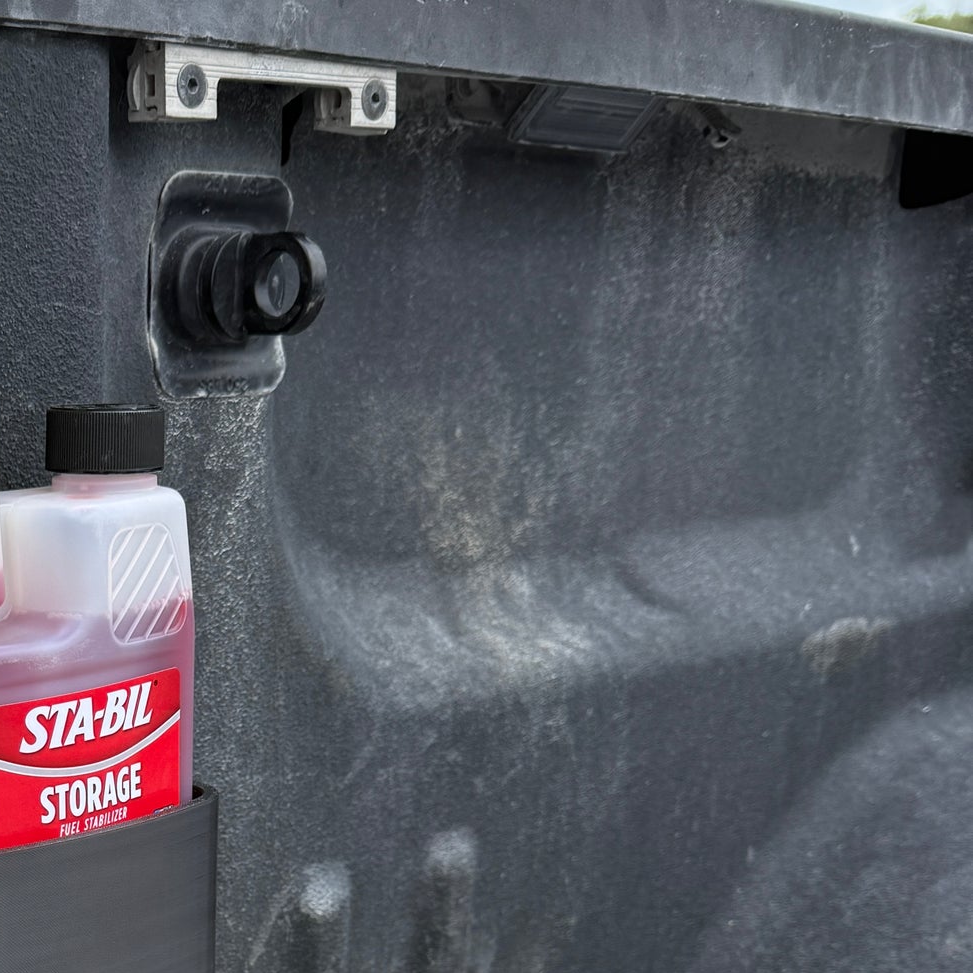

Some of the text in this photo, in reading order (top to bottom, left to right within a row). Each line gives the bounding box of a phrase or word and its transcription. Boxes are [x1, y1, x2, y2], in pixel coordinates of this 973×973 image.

[19, 681, 154, 754] STA-BIL
[39, 762, 142, 824] STORAGE
[59, 806, 128, 837] FUEL STABILIZER
